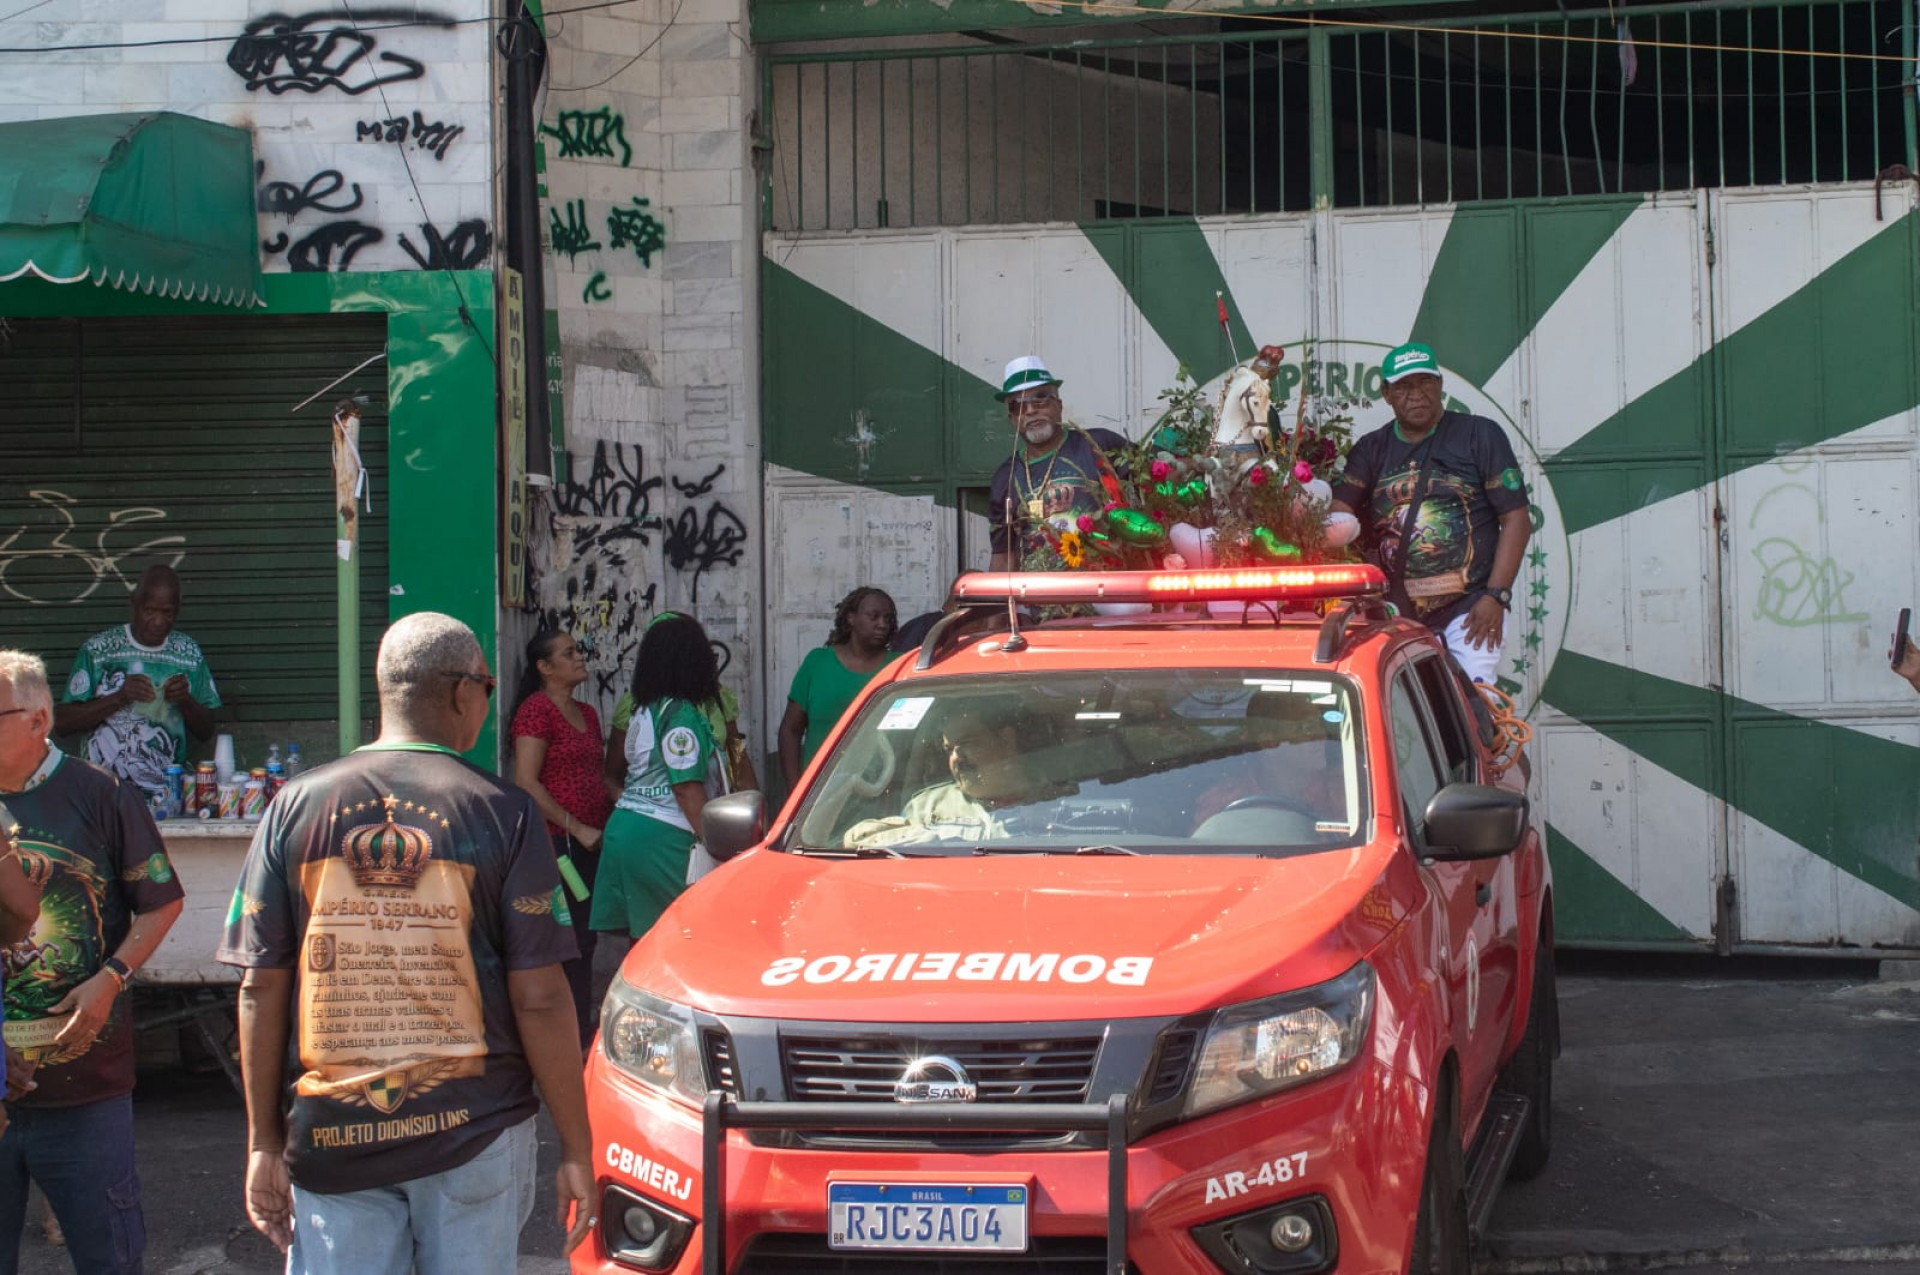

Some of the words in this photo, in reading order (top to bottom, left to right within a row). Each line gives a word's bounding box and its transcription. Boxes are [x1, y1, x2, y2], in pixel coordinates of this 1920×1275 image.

[510, 480, 522, 597] AQUI
[370, 918, 404, 932] 1947
[383, 901, 459, 921] SERRANO
[902, 1084, 967, 1099] NISSAN
[312, 1122, 373, 1148] PROJETO
[377, 1110, 436, 1140] DIONÍSIO
[440, 1108, 470, 1131] LINS
[605, 1142, 692, 1201] CBMERJ
[1204, 1151, 1309, 1204] AR-487
[911, 1191, 944, 1202] BRASIL
[846, 1204, 1002, 1243] RJC3A04
[833, 1232, 845, 1245] BR
